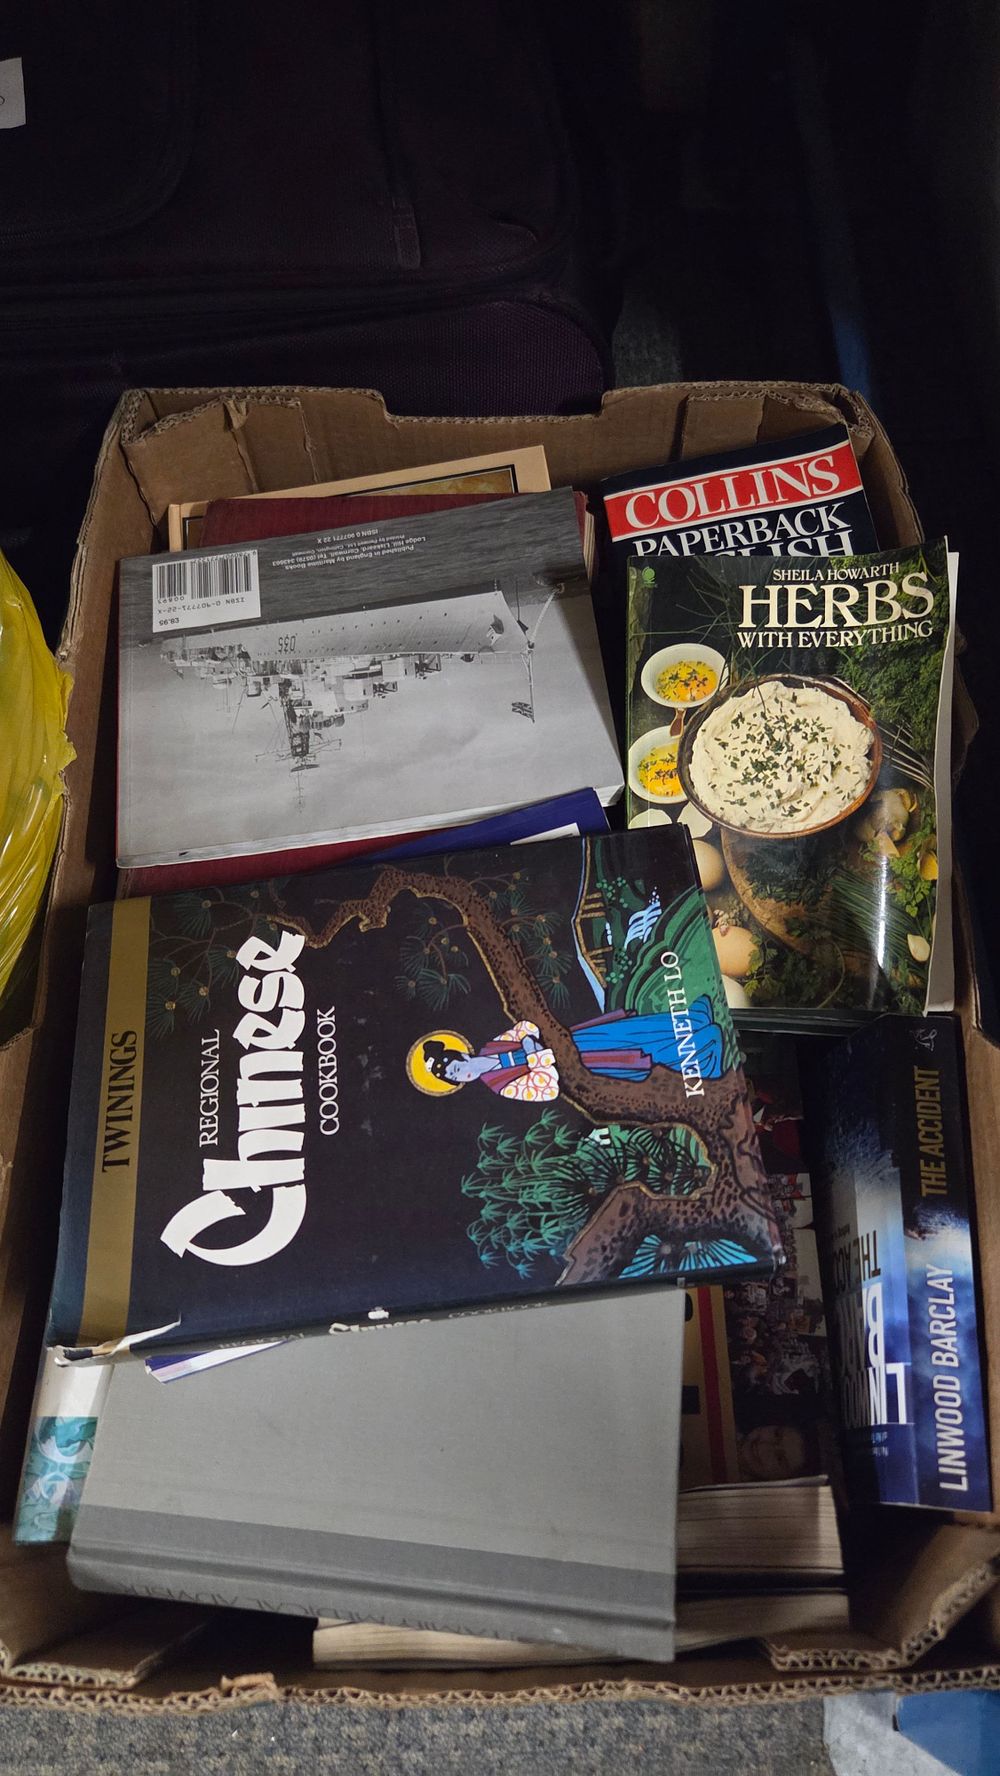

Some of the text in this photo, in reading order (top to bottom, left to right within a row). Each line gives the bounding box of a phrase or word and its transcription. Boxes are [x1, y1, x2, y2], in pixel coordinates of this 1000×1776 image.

[625, 455, 840, 530] COLLINS
[346, 551, 372, 561] England
[381, 545, 414, 554] Published
[405, 536, 425, 544] Lodge
[633, 502, 851, 557] PAPERBACK
[738, 571, 935, 629] HERBS
[772, 561, 900, 582] SHEILA HOWARTH
[158, 617, 180, 627] £8.95
[225, 597, 245, 605] ISBN
[737, 620, 934, 648] WITH EVERYTHING
[660, 951, 705, 1098] KENNETH LO
[160, 930, 307, 1266] Chinese
[199, 1028, 221, 1148] REGIONAL
[317, 1005, 340, 1137] COOKBOOK
[102, 1030, 137, 1173] TWININGS
[914, 1065, 948, 1197] THE ACCIDENT
[926, 1264, 968, 1492] LINWOOD BARCLAY
